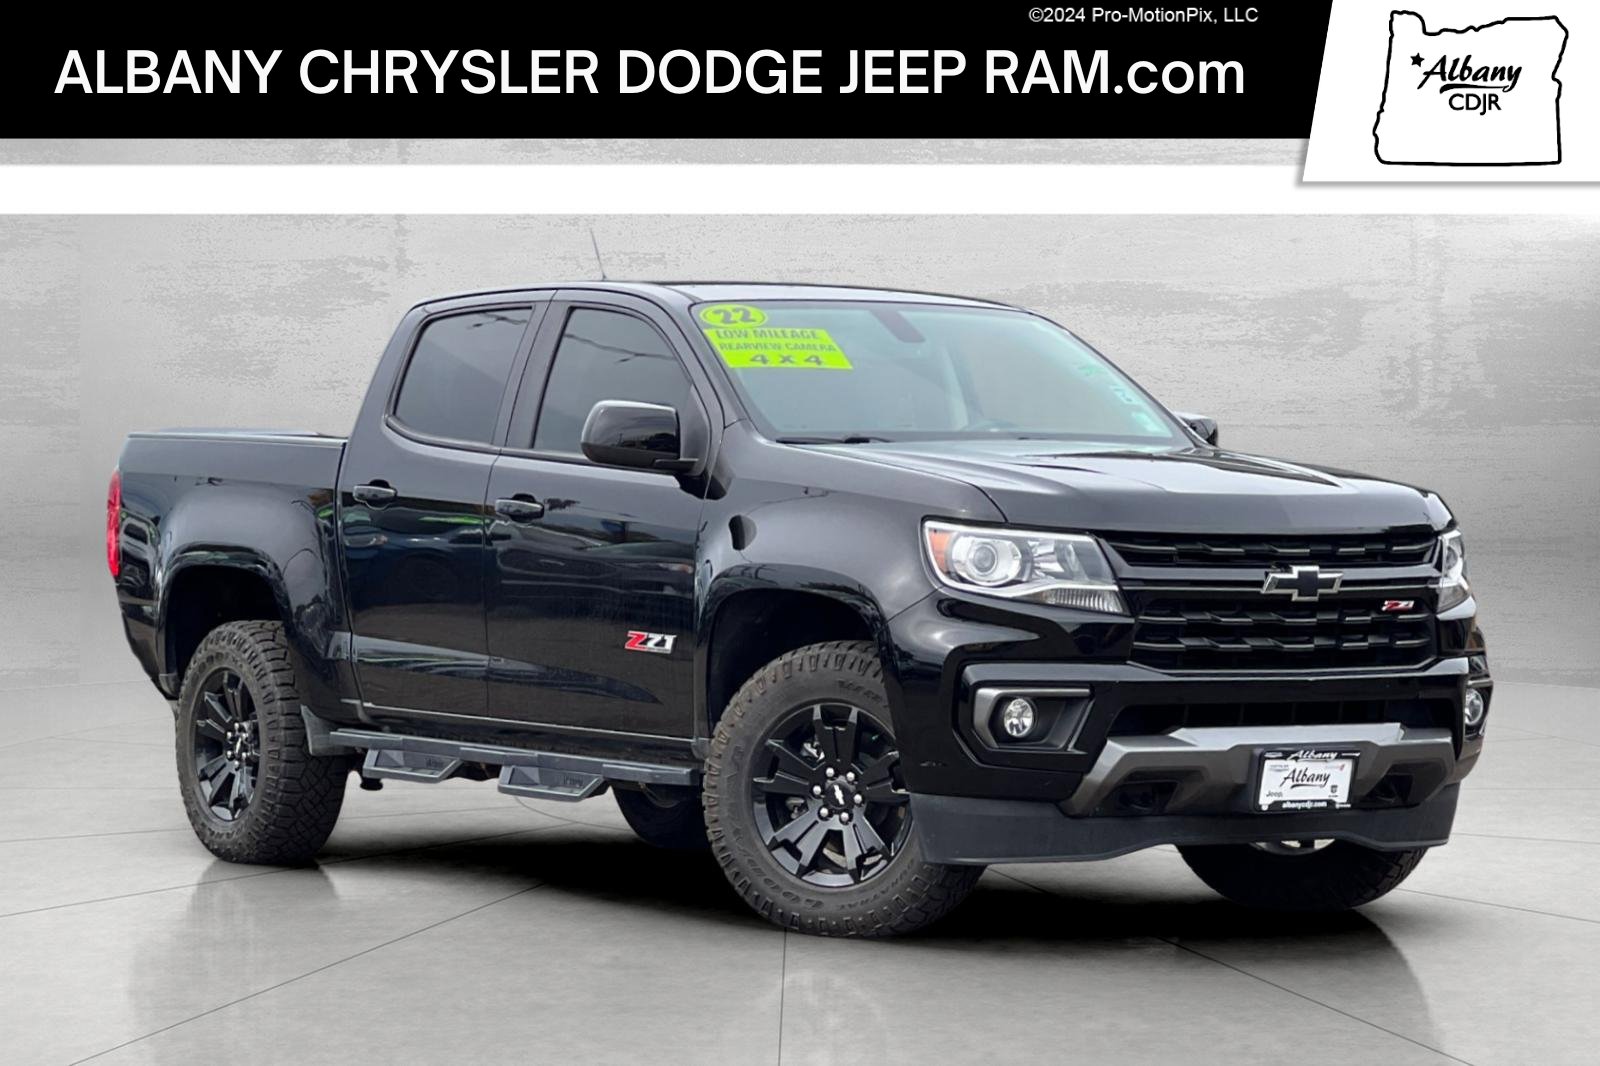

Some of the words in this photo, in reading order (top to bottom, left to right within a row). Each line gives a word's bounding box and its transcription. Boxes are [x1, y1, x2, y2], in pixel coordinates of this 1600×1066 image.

[712, 307, 757, 324] 22
[715, 330, 748, 339] LOW
[753, 329, 819, 339] MILEAGE
[719, 342, 782, 350] REARVIEW
[785, 342, 837, 351] CAMERA
[624, 630, 678, 654] Z71
[1279, 767, 1331, 789] Albany
